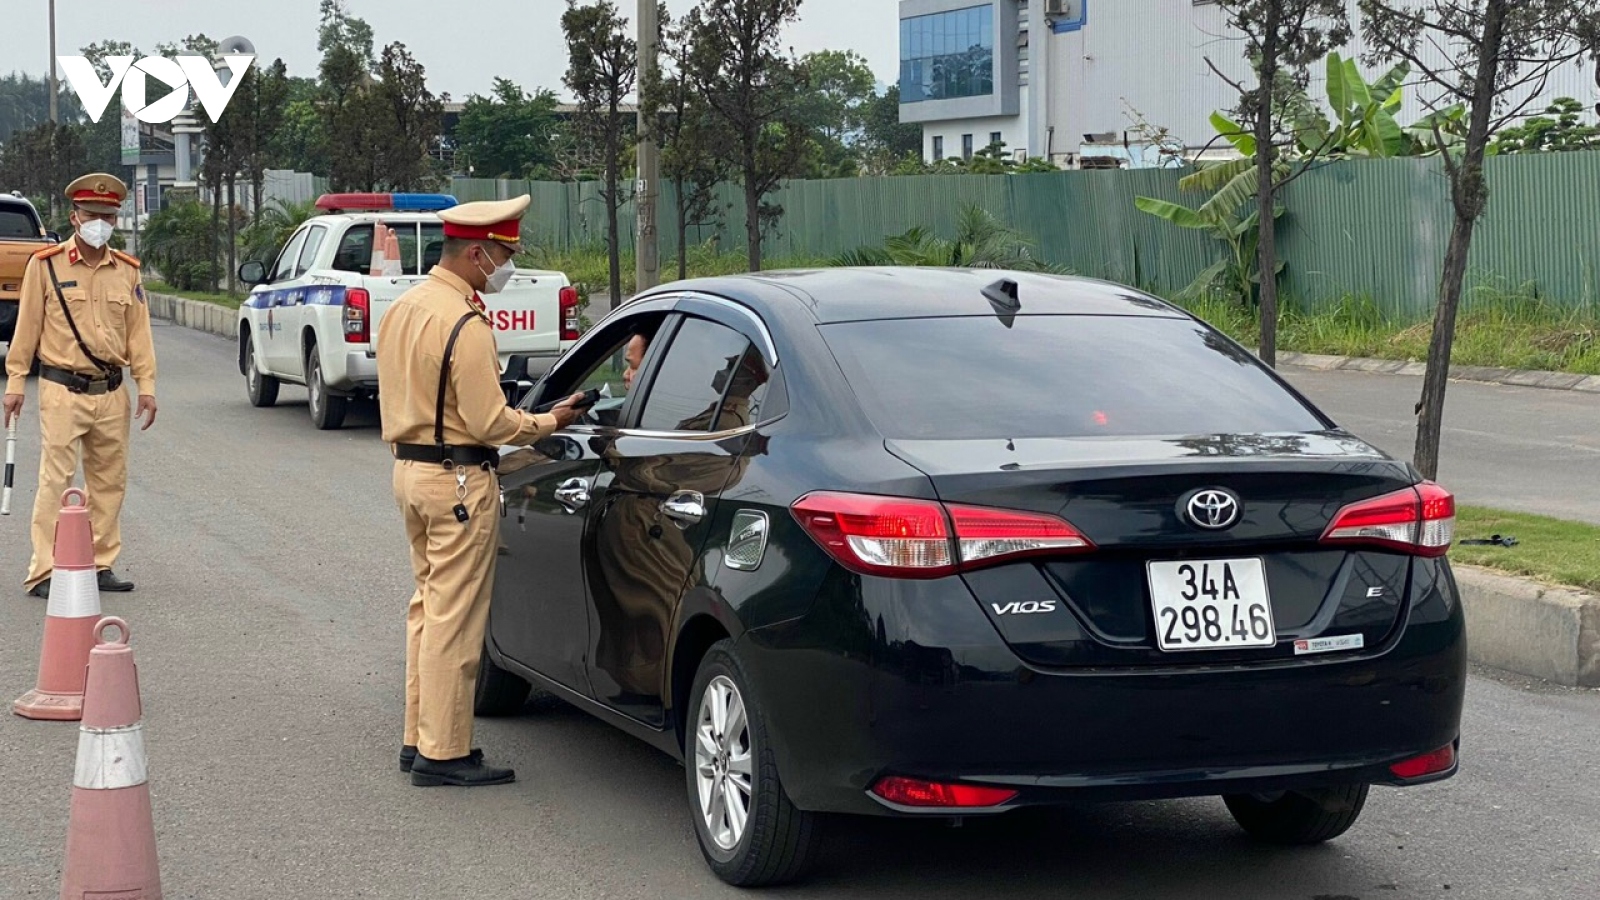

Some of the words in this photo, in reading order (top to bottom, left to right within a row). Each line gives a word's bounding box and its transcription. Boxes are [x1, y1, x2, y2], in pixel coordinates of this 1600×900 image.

[488, 310, 536, 331] ISHI
[1178, 562, 1240, 601] 34A
[1366, 586, 1384, 598] E
[991, 600, 1057, 615] VIOS
[1160, 603, 1268, 644] 298.46
